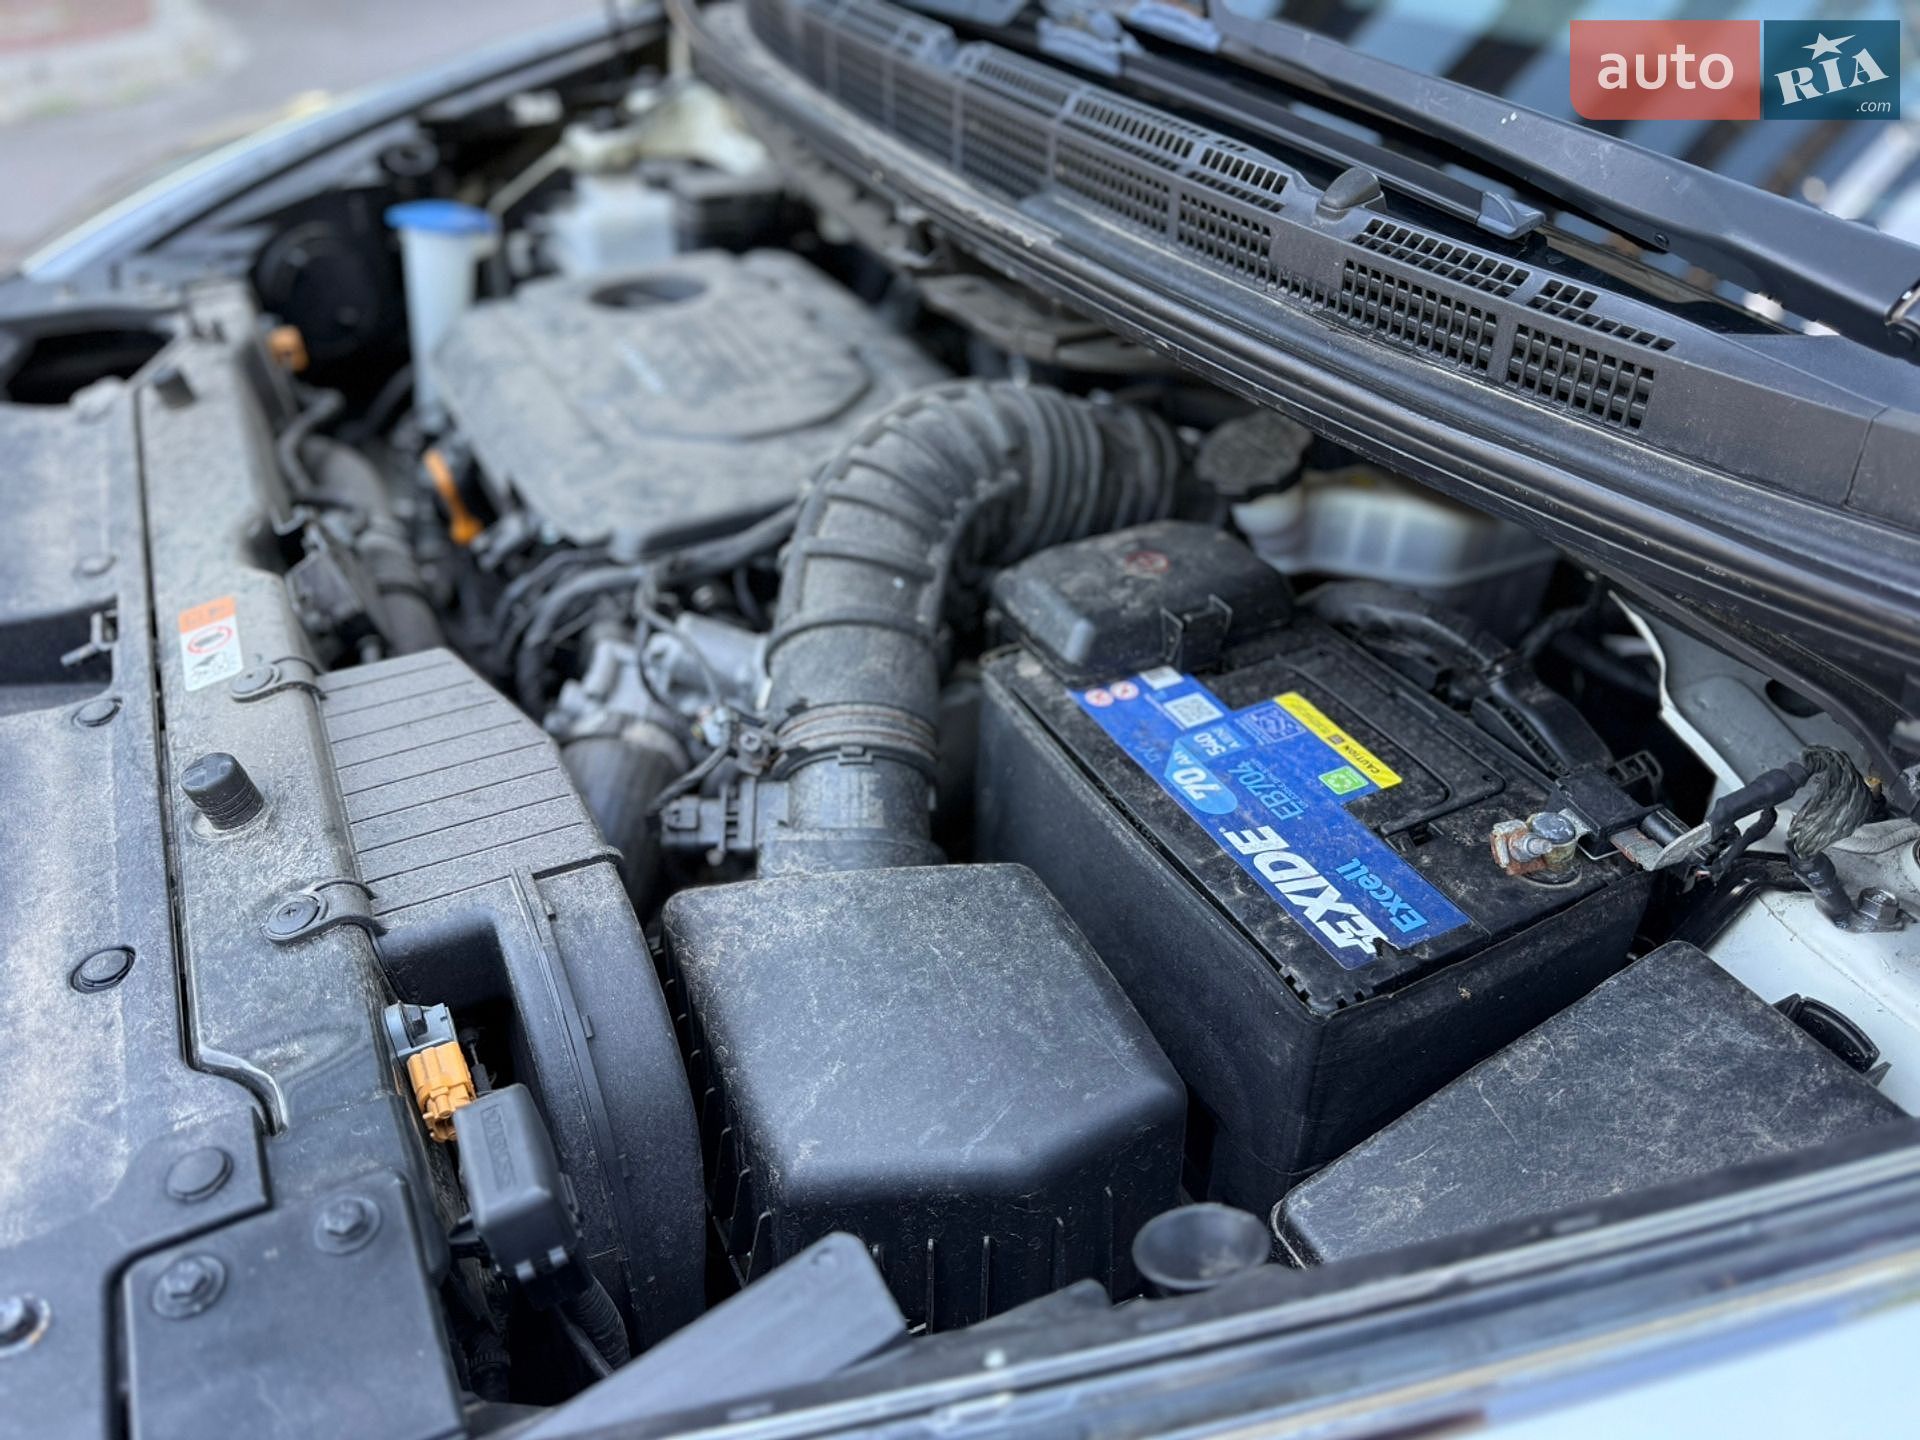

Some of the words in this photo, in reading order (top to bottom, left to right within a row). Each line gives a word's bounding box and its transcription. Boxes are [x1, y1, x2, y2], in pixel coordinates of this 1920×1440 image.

[1193, 731, 1227, 757] 540
[1343, 744, 1380, 775] CAUTION
[1172, 766, 1223, 801] 70
[1227, 760, 1305, 821] EB704
[1223, 825, 1389, 955] EXIDE
[1335, 857, 1429, 934] Excell
